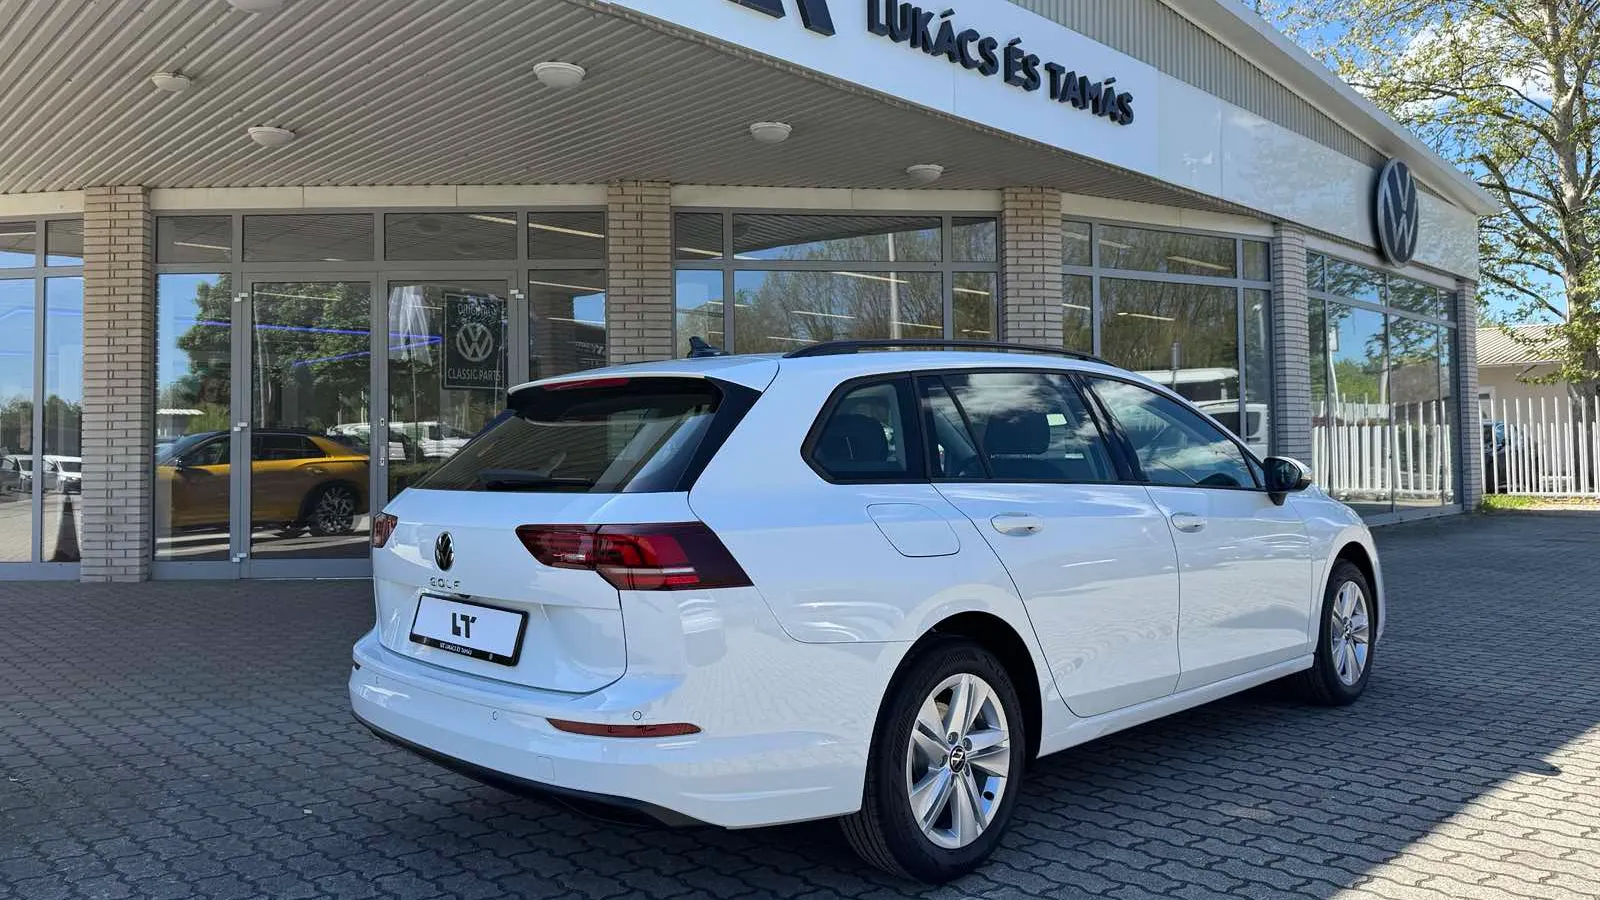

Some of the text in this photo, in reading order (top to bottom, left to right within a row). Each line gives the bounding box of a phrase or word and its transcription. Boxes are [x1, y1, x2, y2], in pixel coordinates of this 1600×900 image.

[867, 0, 999, 76] LUKÁCS
[1003, 37, 1041, 92] ÉS
[1044, 61, 1134, 126] TAMÁS
[456, 323, 494, 362] VW
[448, 367, 501, 382] CLASSIC PARTS
[430, 577, 460, 589] GOLF
[451, 612, 477, 639] LT
